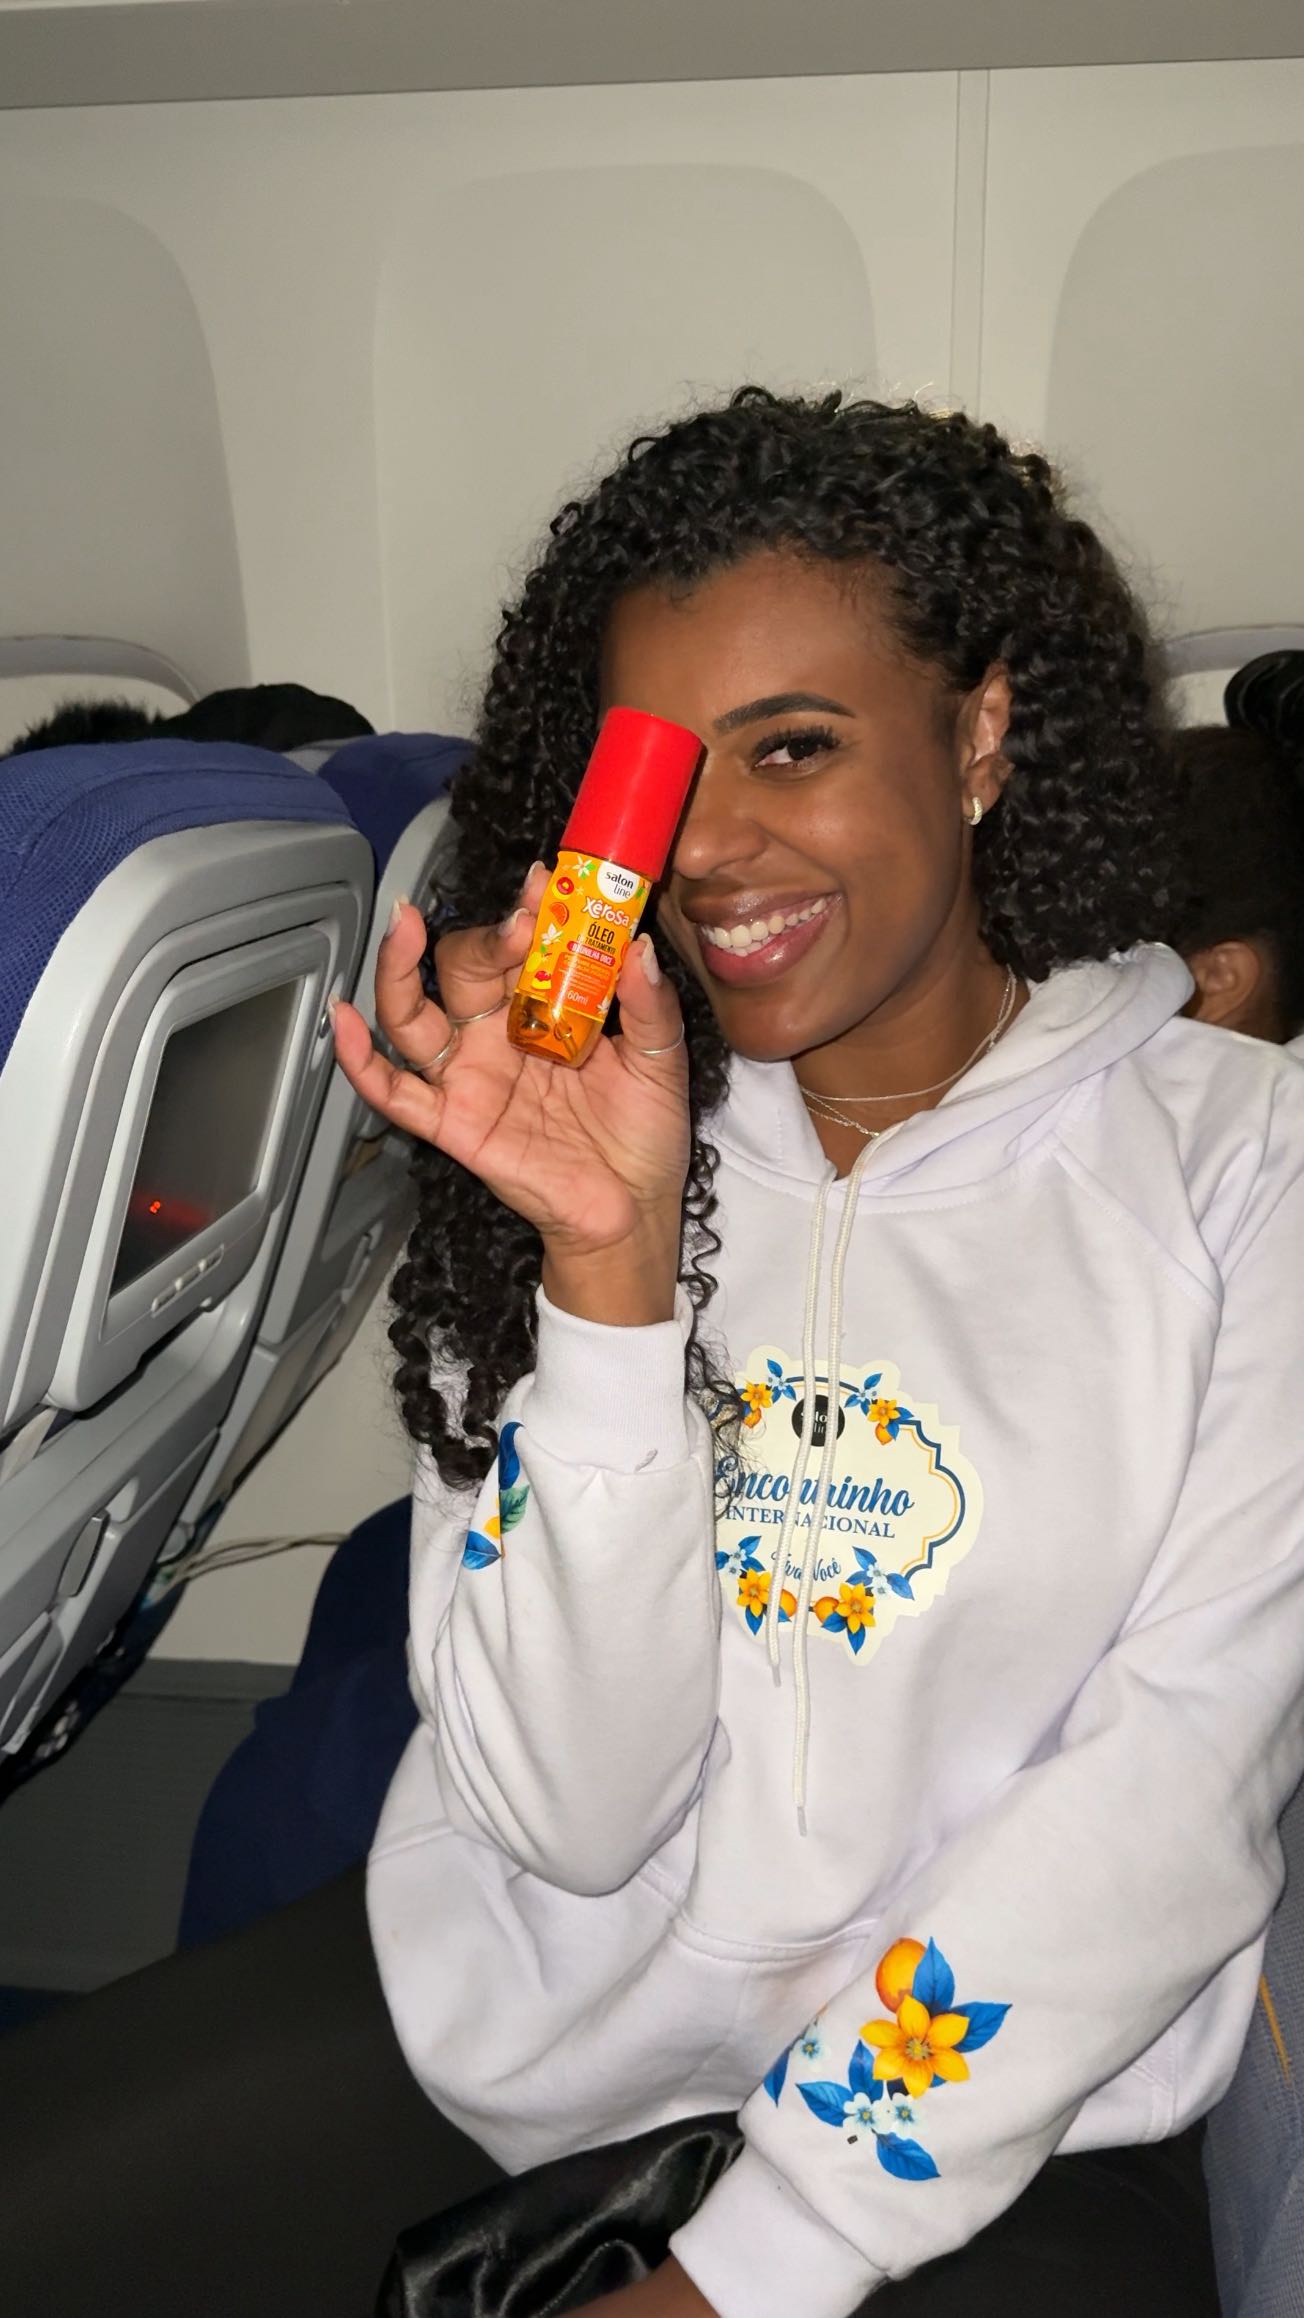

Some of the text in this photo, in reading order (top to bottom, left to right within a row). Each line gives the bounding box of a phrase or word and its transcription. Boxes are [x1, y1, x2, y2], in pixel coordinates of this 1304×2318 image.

[605, 871, 635, 890] salon
[613, 885, 632, 899] line
[588, 921, 616, 945] ÓLEO
[567, 990, 589, 1006] 60ml
[771, 1551, 803, 1581] iva
